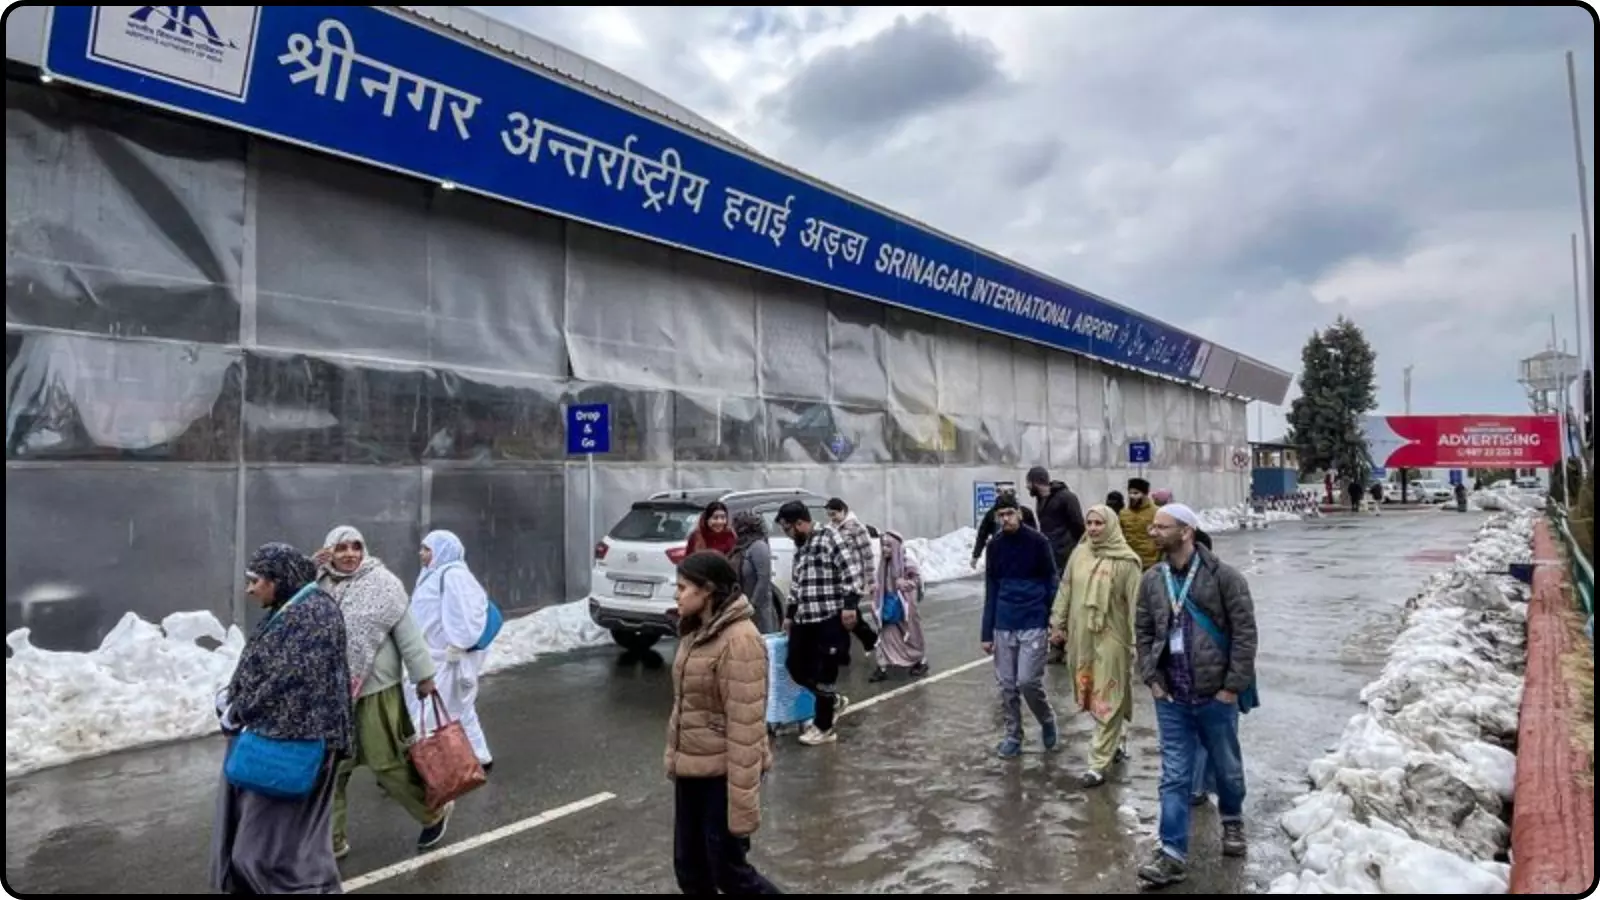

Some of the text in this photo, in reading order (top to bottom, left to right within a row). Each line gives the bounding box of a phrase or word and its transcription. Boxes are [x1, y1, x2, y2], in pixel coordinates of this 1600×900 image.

[278, 19, 482, 140] श्रीनगर
[723, 187, 795, 247] हवाई
[875, 243, 1119, 343] SRINAGAR INTERNATIONAL AIRPORT
[575, 410, 600, 423] Drop
[583, 423, 593, 434] &
[581, 437, 596, 448] Go
[1437, 433, 1541, 446] ADVERTISING
